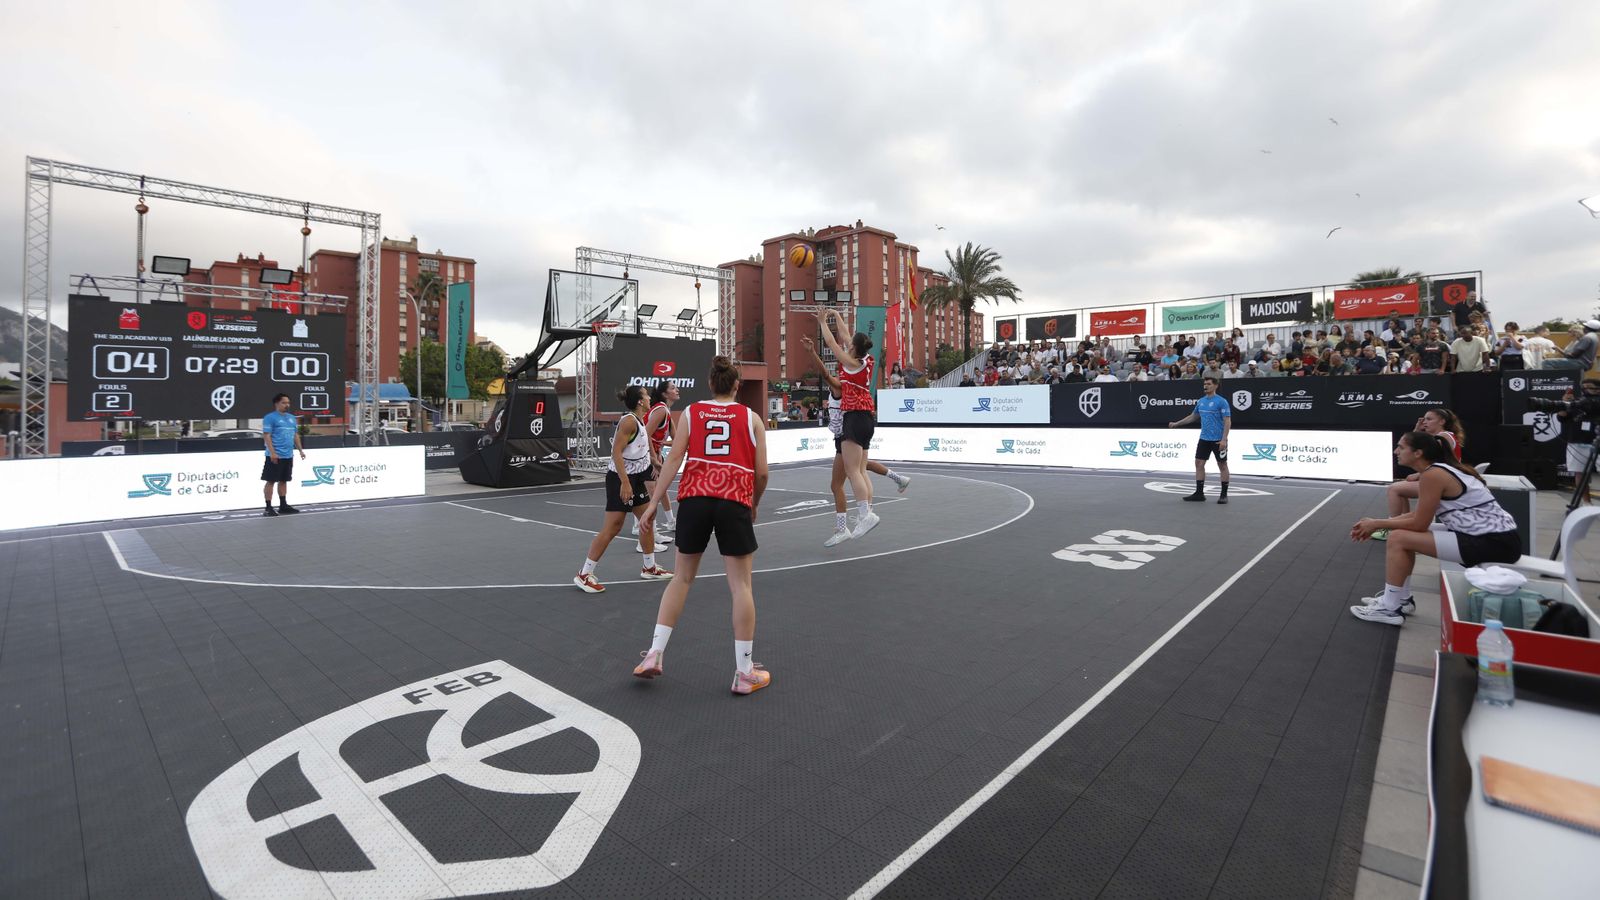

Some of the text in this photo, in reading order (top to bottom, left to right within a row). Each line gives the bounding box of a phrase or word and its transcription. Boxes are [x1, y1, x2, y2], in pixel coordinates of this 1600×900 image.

[1250, 300, 1297, 317] MADISON
[107, 351, 157, 373] 04
[185, 357, 258, 374] 07:29
[281, 357, 320, 376] 00
[626, 377, 659, 389] JOHN
[106, 395, 120, 408] 2
[310, 396, 319, 407] 1
[536, 402, 544, 414] 0
[705, 420, 730, 456] 2
[1141, 440, 1187, 450] Diputación
[1281, 444, 1338, 454] Diputación
[1155, 448, 1180, 458] Cádiz
[1297, 453, 1328, 464] Cádiz
[339, 463, 386, 473] Diputación
[178, 470, 239, 482] Diputación
[354, 474, 378, 484] Cádiz
[178, 484, 228, 495] de Cádiz
[402, 672, 502, 705] FEB
